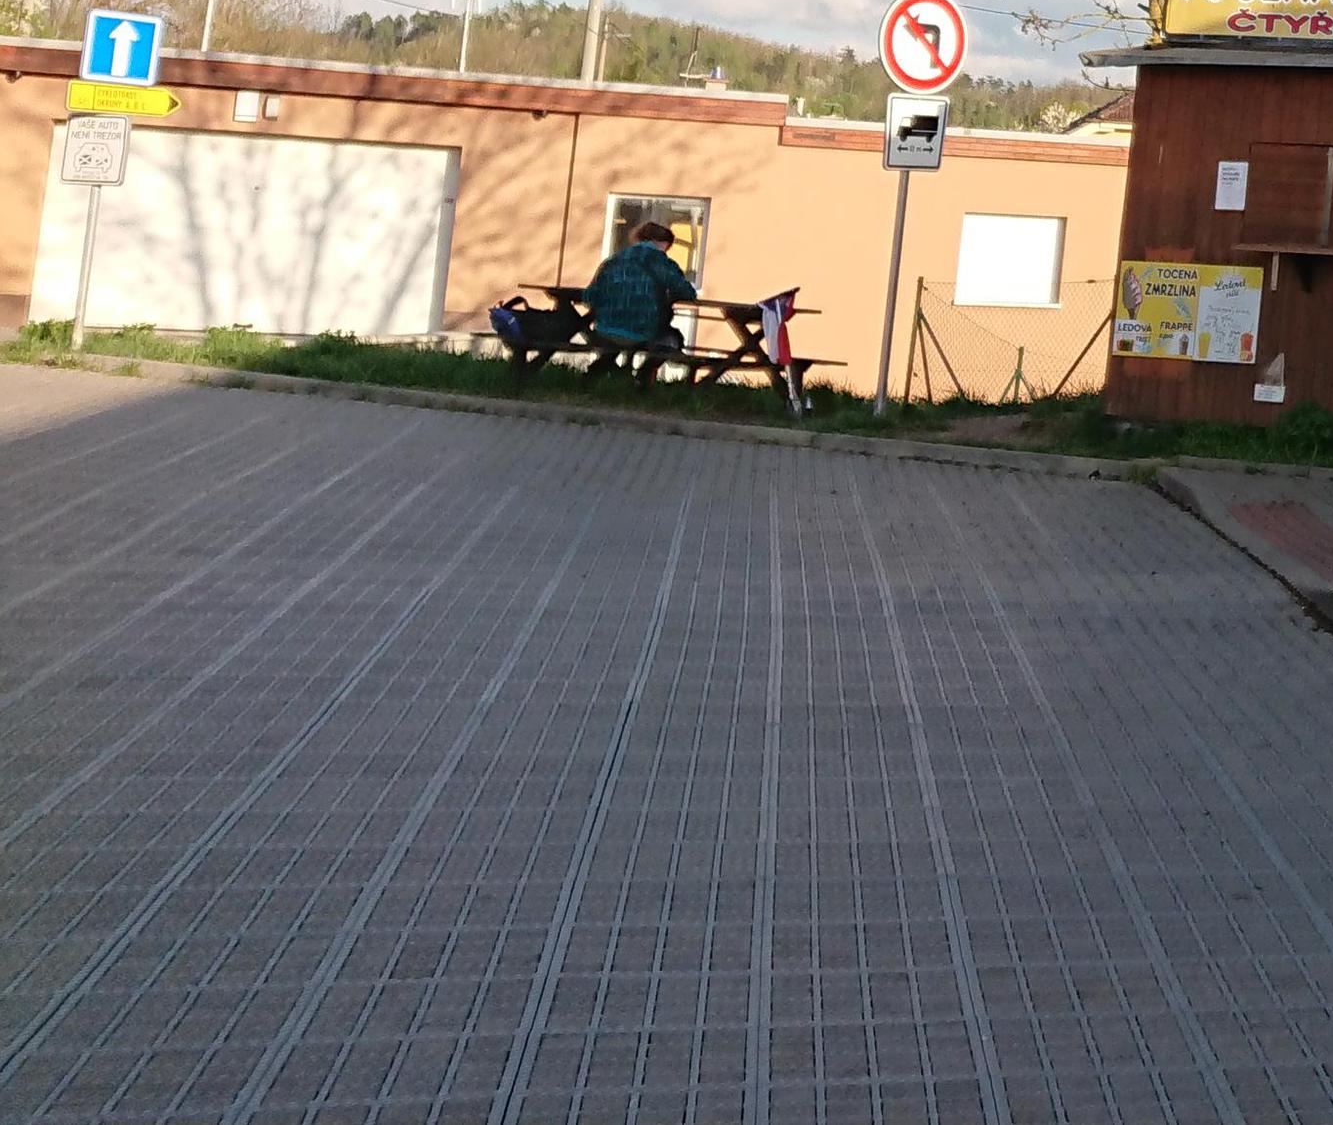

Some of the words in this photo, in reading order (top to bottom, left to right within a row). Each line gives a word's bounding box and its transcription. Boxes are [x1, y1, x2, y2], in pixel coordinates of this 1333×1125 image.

[77, 119, 96, 129] VAŠE
[98, 121, 119, 130] AUTO
[93, 132, 122, 140] TREZOR
[1145, 283, 1197, 297] ZMRZLINA
